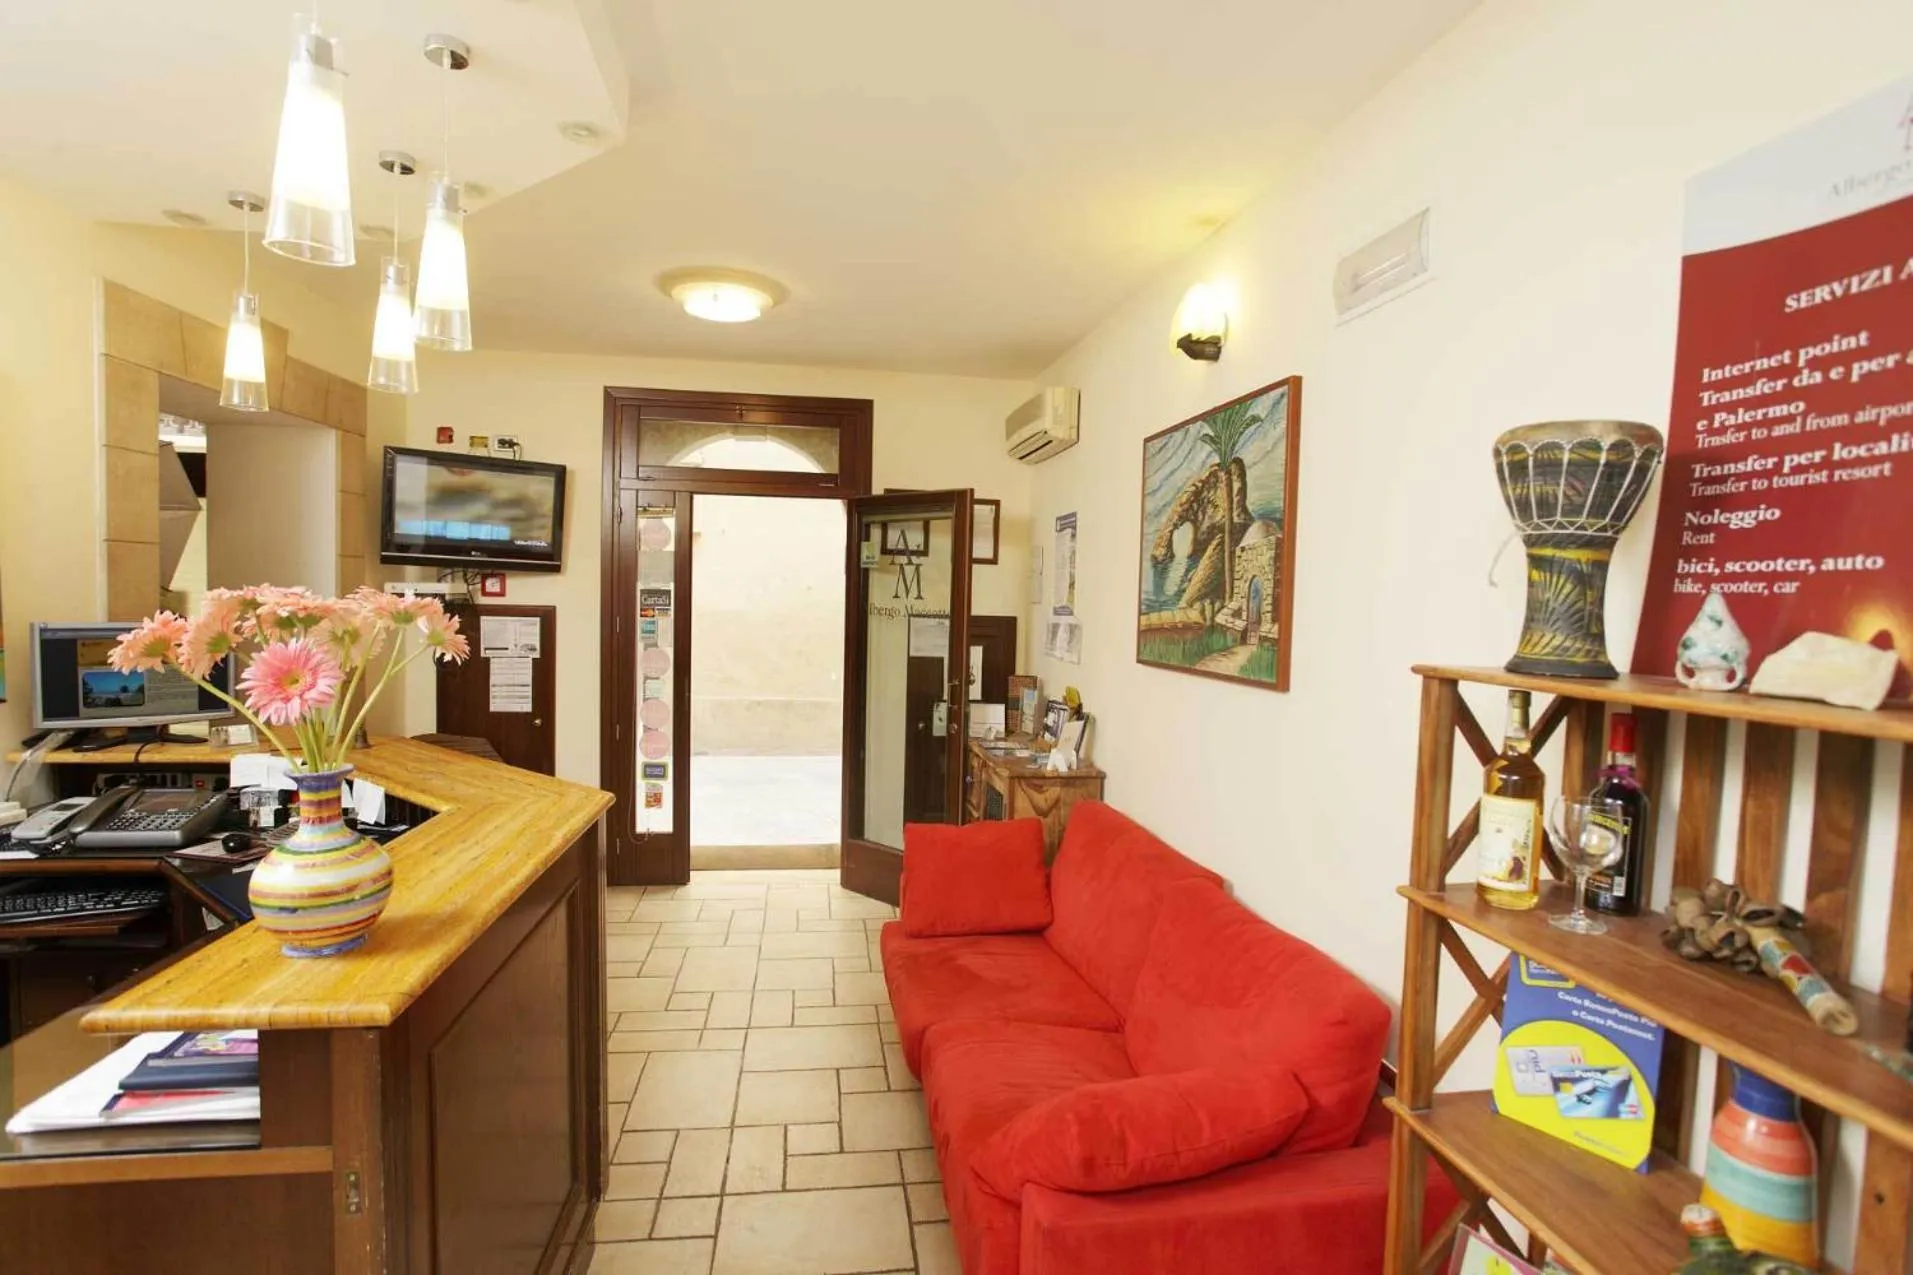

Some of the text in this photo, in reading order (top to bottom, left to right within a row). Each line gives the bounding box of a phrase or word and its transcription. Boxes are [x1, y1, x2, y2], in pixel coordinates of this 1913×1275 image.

[1783, 264, 1894, 313] SERVIZI
[1702, 330, 1870, 384] Internet point
[1699, 378, 1789, 407] Transfer
[1792, 367, 1824, 388] da
[1829, 365, 1846, 381] e
[1850, 352, 1902, 383] per
[1696, 401, 1807, 432] e Palermo
[1751, 427, 1769, 441] to
[1770, 414, 1802, 438] and
[1805, 412, 1850, 432] from
[1691, 431, 1913, 479] Transfer per locali
[1689, 460, 1893, 498] Transfer to tourist resort
[1684, 504, 1782, 529] Noleggio
[1681, 530, 1717, 546] Rent
[1677, 553, 1886, 576] bici, scooter, auto
[1673, 577, 1801, 597] bike, scooter, car
